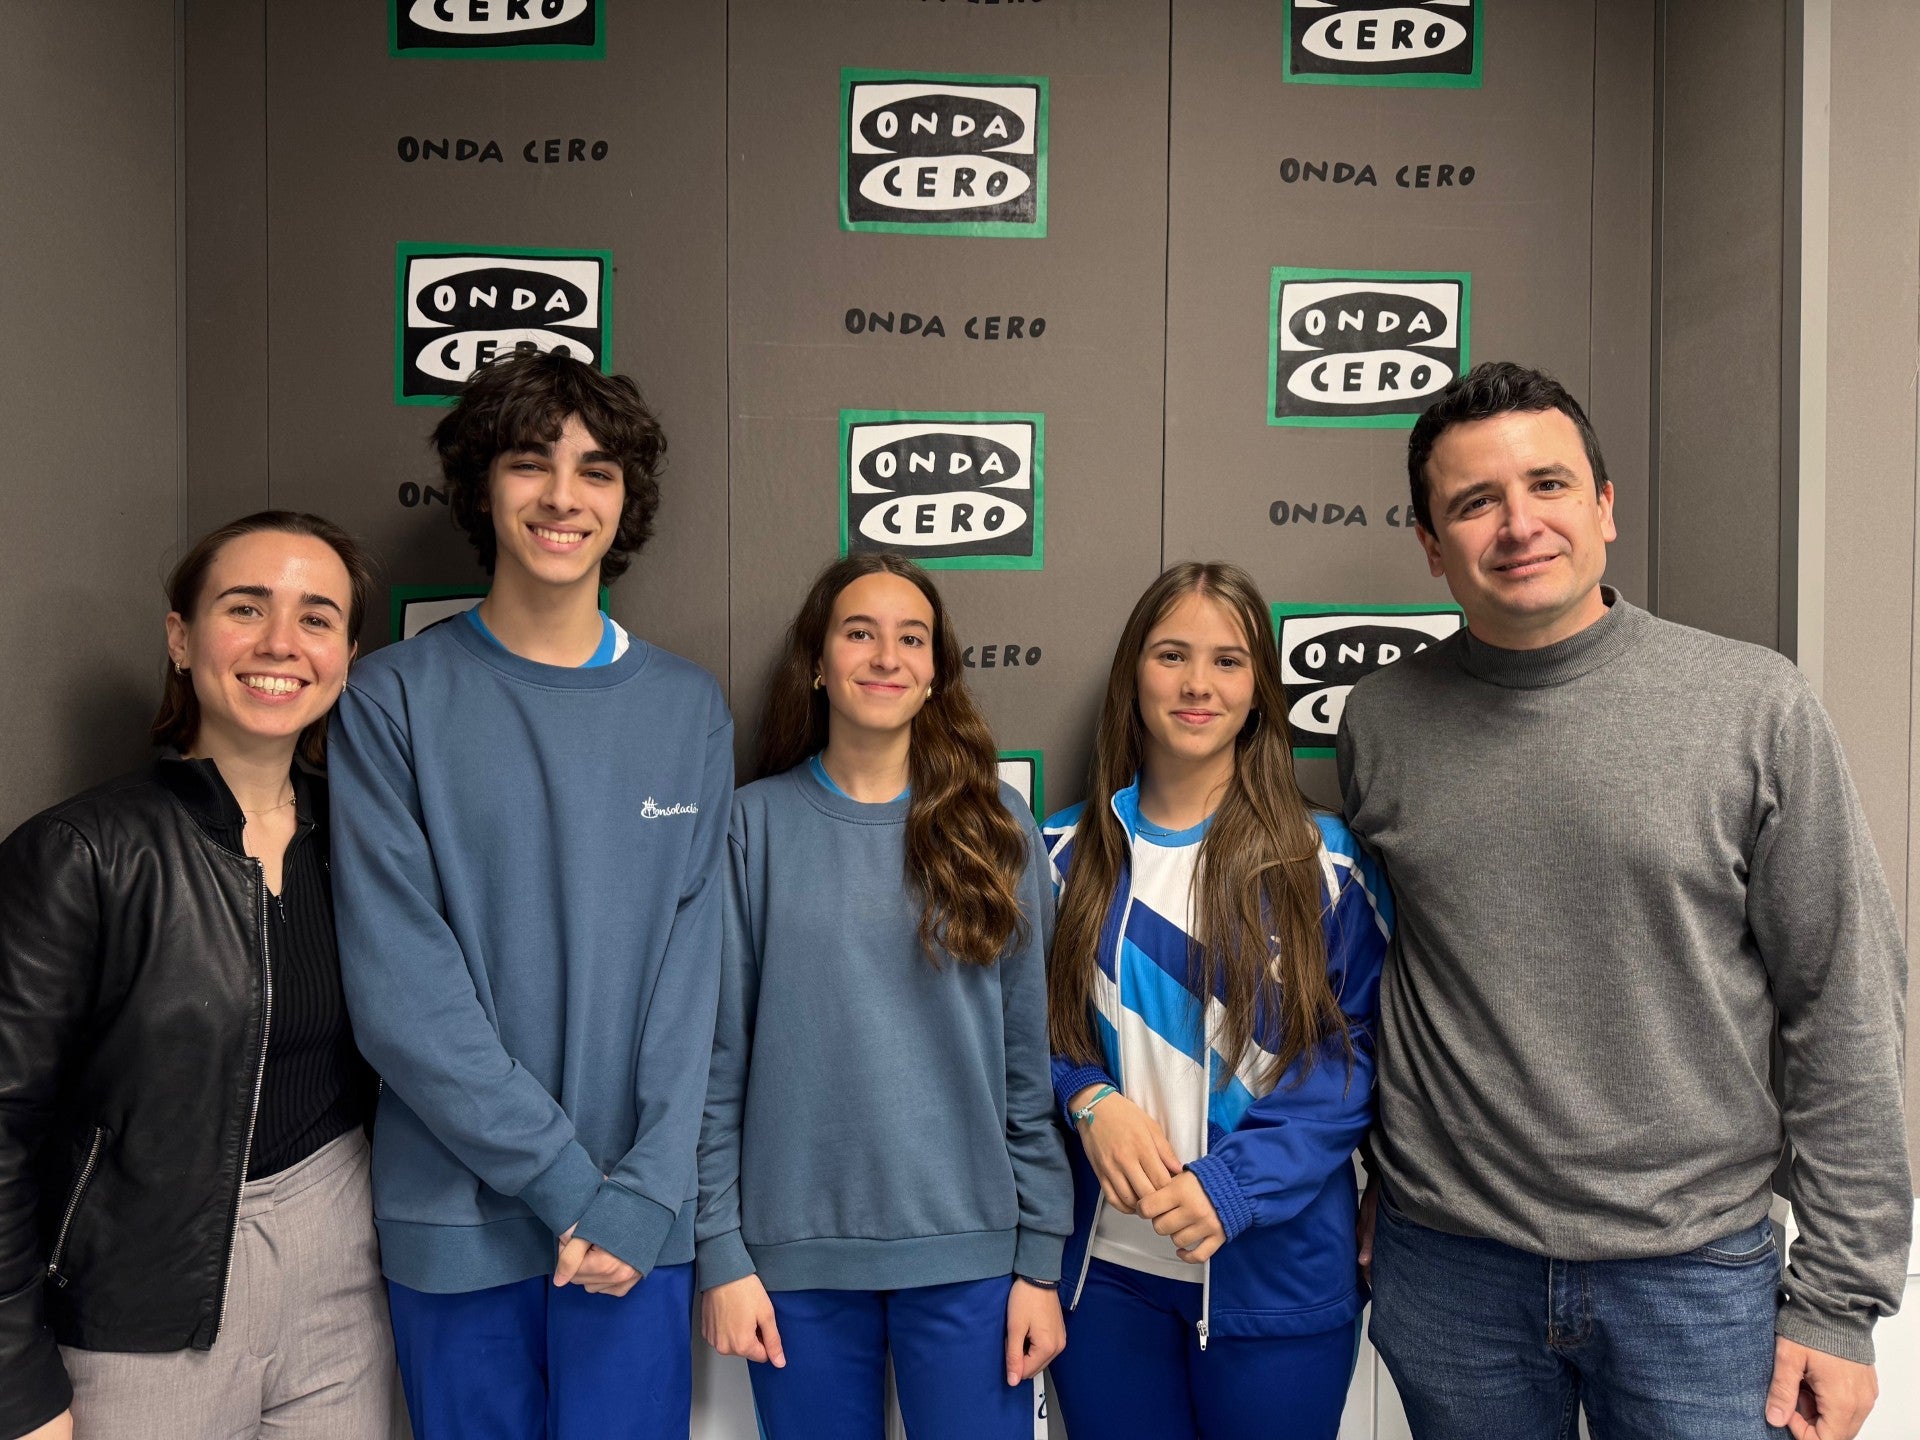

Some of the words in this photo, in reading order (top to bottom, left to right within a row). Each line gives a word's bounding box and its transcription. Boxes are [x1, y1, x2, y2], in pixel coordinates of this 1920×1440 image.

[433, 0, 564, 22] CERO
[1325, 19, 1446, 50] CERO
[877, 111, 1008, 139] ONDA
[397, 136, 504, 163] ONDA
[523, 138, 609, 163] CERO
[883, 166, 1008, 197] CERO
[1280, 158, 1377, 187] ONDA
[1396, 165, 1476, 188] CERO
[433, 285, 570, 312] ONDA
[845, 308, 946, 338] ONDA
[964, 316, 1046, 340] CERO
[1305, 309, 1431, 334] ONDA
[1311, 361, 1432, 392] CERO
[875, 451, 1004, 478] ONDA
[399, 481, 449, 508] ON
[882, 503, 1005, 534] CERO
[1269, 500, 1367, 526] ONDA
[1386, 505, 1418, 527] CE
[962, 644, 1042, 668] CERO
[1305, 642, 1427, 669] OND
